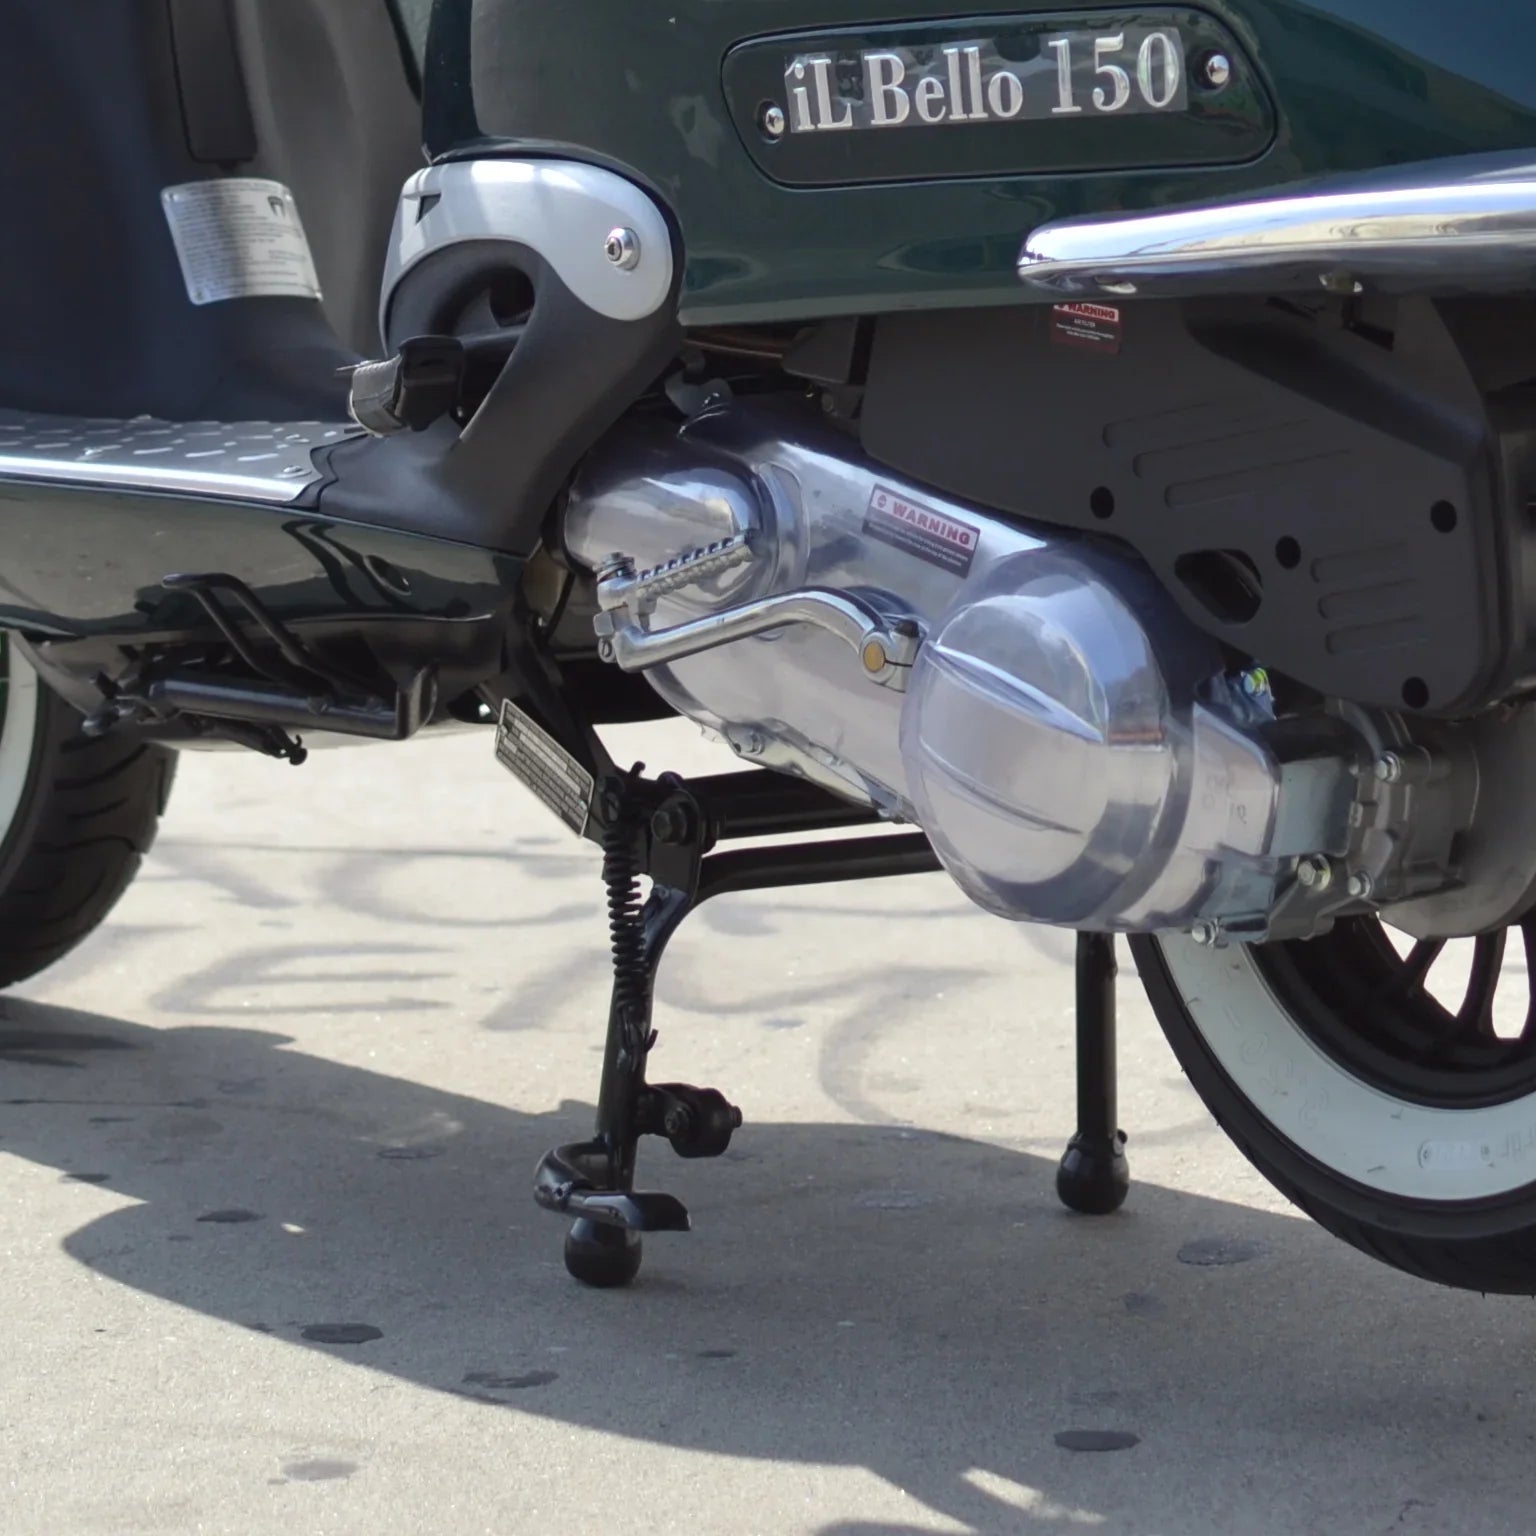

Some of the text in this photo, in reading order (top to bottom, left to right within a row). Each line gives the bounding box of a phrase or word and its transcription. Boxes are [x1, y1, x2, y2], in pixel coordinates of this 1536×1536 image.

[864, 45, 1024, 126] Bello
[1048, 31, 1180, 114] 150
[1067, 303, 1116, 321] WARNING
[893, 500, 971, 546] WARNING
